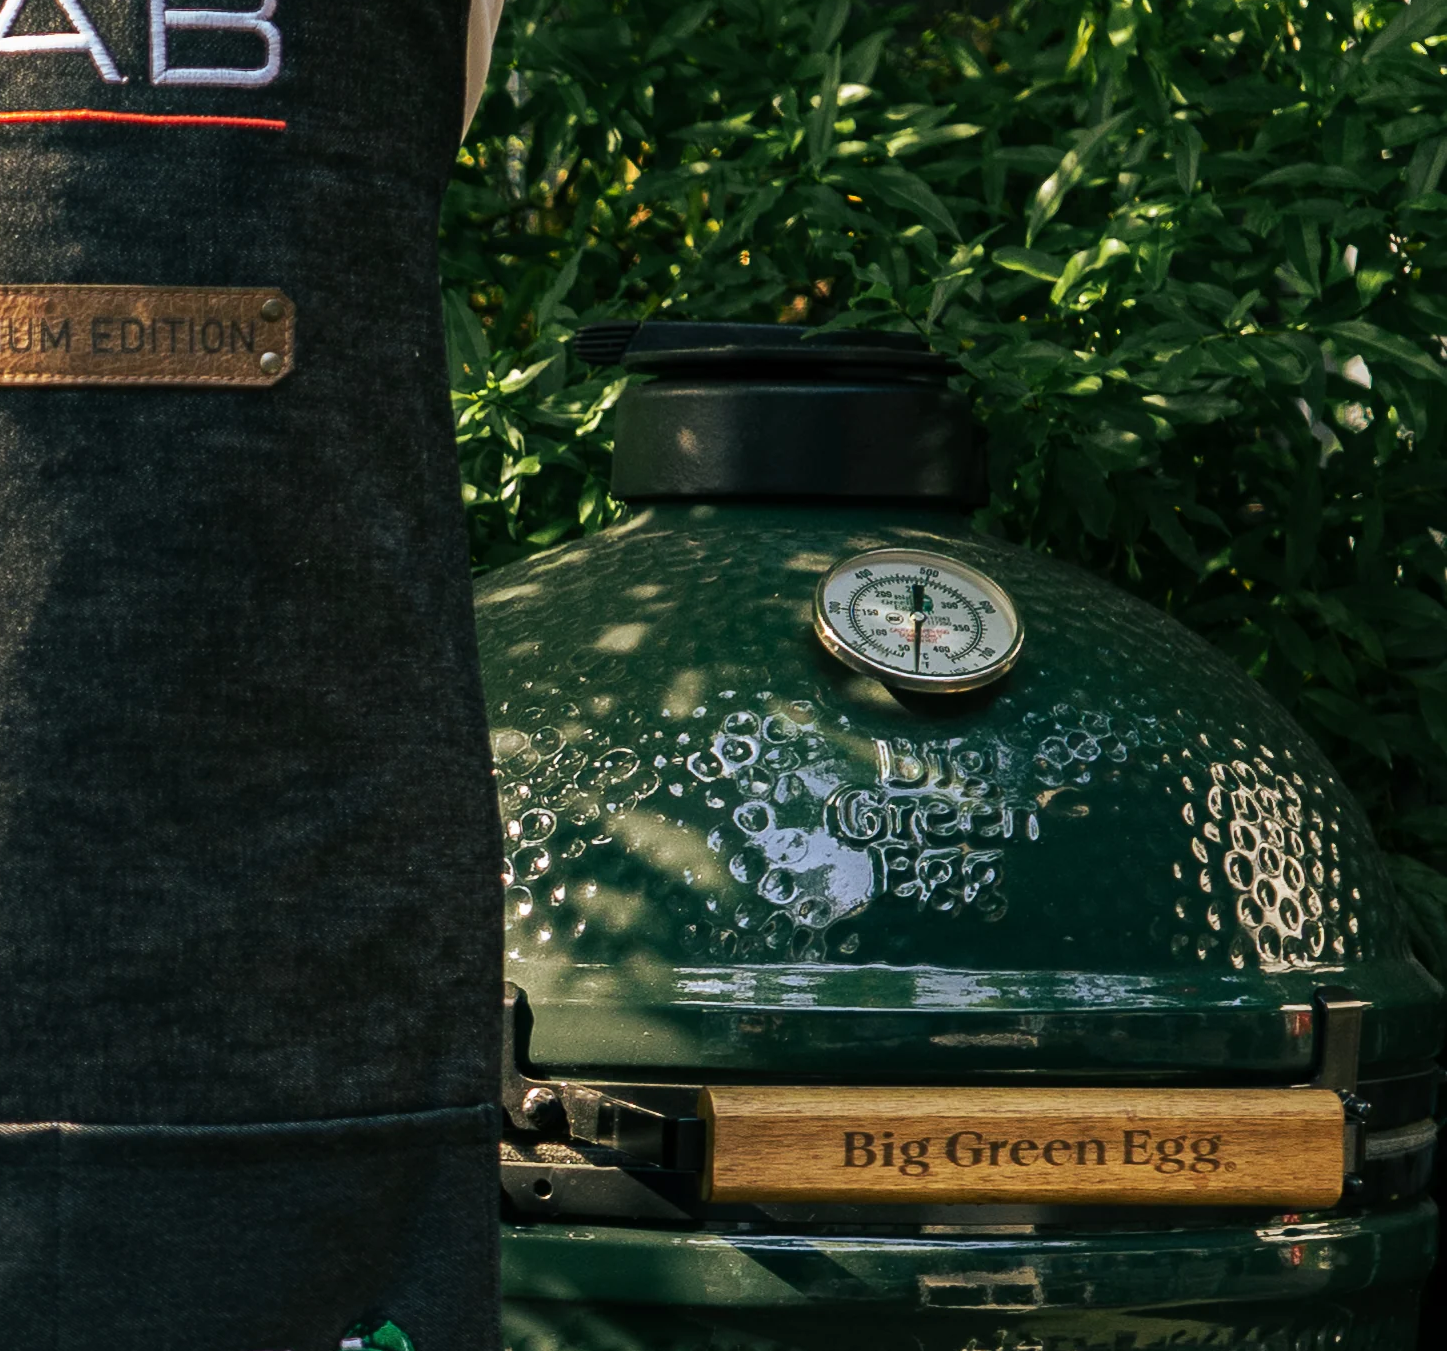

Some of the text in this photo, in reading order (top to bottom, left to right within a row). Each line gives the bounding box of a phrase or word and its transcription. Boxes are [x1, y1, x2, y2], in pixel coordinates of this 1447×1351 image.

[91, 317, 255, 355] EDITION
[919, 567, 939, 578] 500
[825, 782, 1040, 840] Green
[842, 1131, 931, 1176] Big
[945, 1130, 1107, 1167] Green
